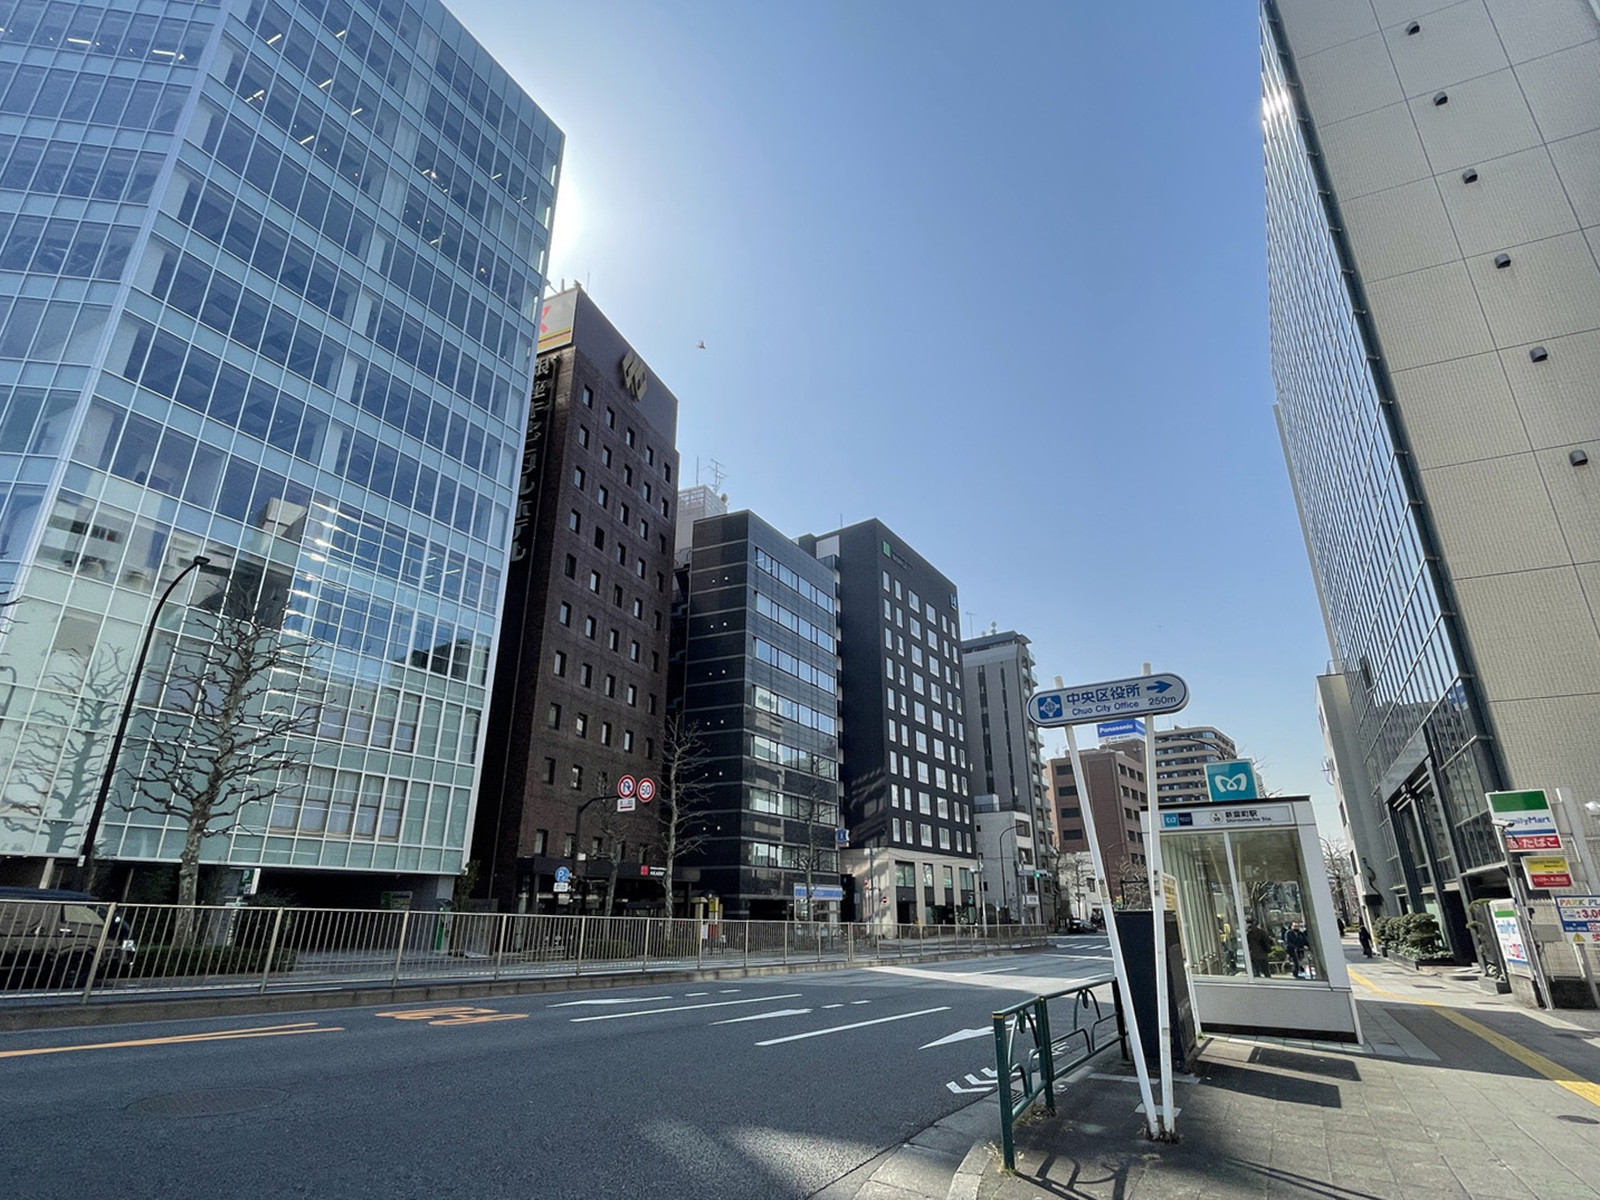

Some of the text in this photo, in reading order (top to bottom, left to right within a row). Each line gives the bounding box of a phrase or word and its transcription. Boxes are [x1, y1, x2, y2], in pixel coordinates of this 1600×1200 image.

[1066, 683, 1141, 705] 中央区役所
[1148, 696, 1177, 706] 250m
[1072, 701, 1140, 716] Chuo City Office
[1099, 723, 1134, 734] Panasonic
[641, 784, 651, 796] 50
[1559, 898, 1585, 906] PARK
